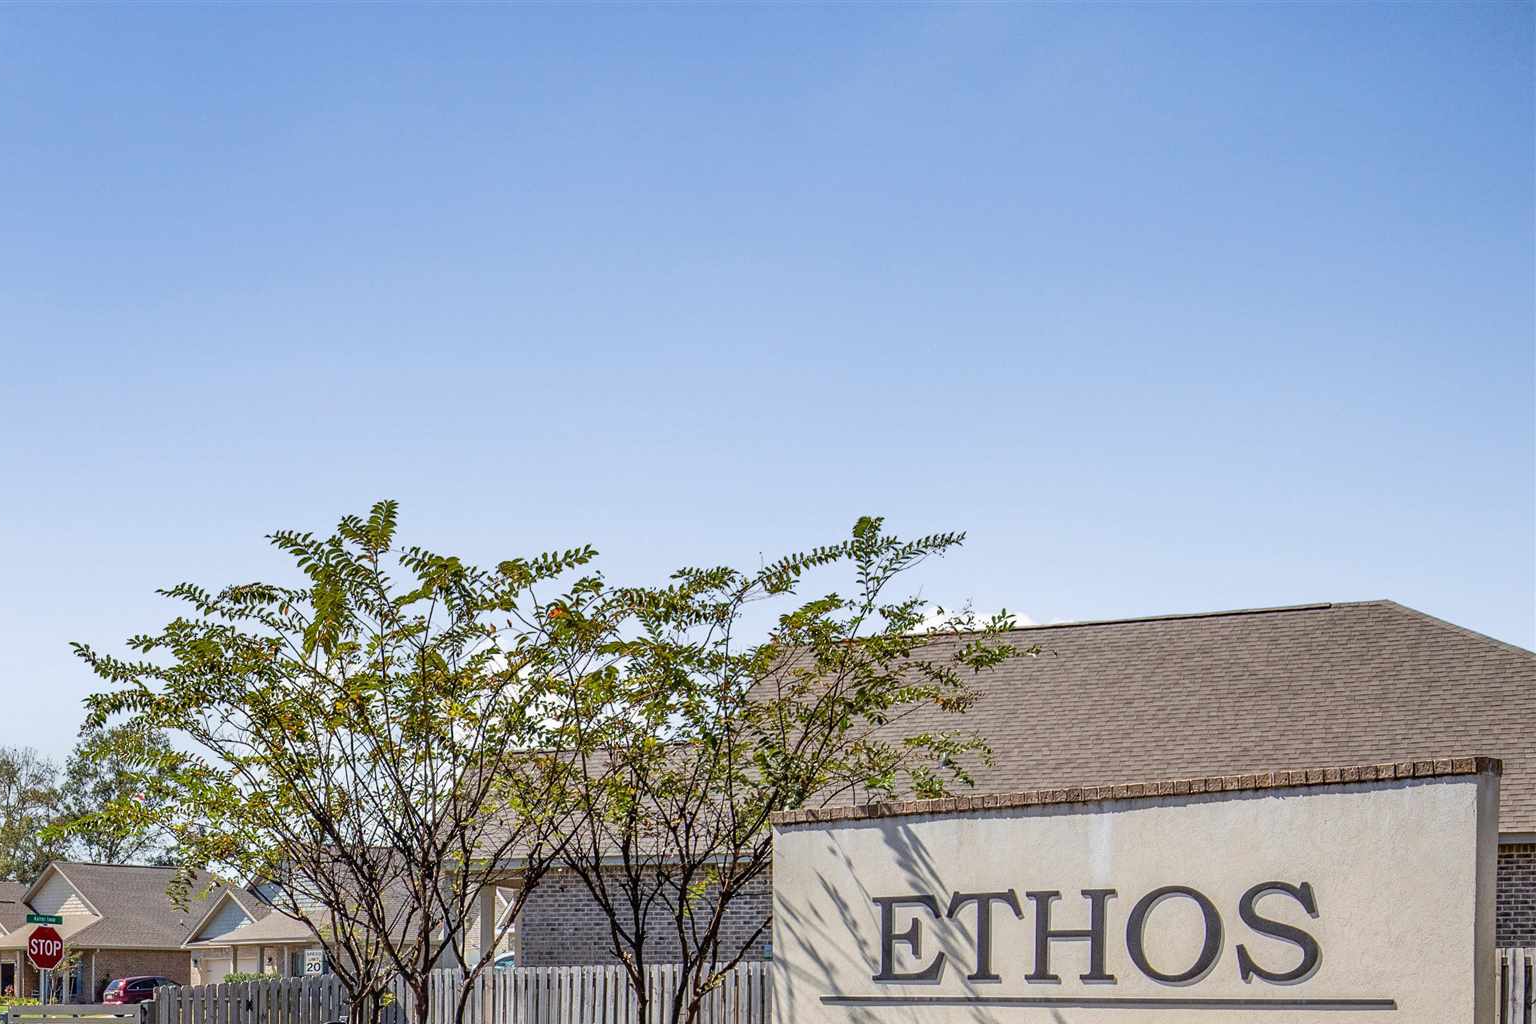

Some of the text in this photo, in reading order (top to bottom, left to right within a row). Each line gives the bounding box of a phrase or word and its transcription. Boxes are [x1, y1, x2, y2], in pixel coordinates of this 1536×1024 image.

[872, 881, 1322, 985] ETHOS
[30, 938, 62, 957] STOP
[307, 962, 321, 972] 20
